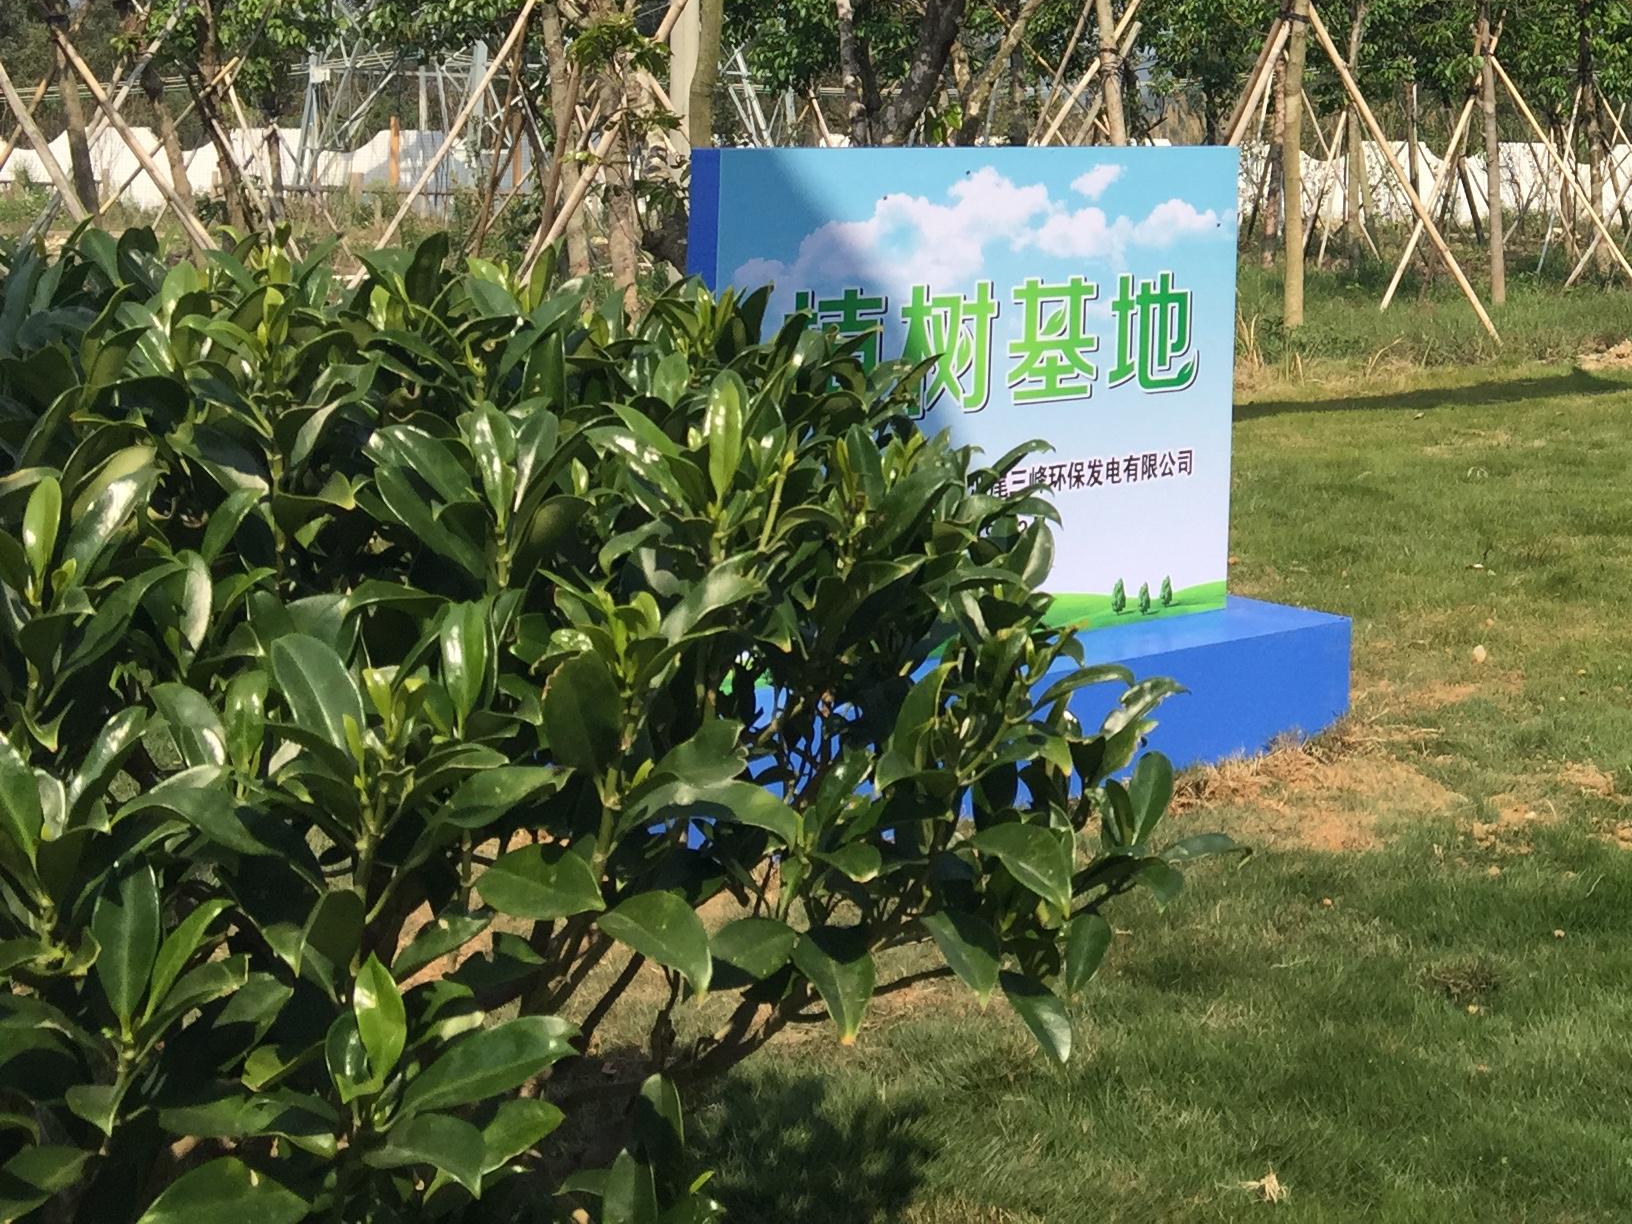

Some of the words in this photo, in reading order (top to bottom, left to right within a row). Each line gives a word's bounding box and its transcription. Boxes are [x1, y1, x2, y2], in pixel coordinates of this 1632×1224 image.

[968, 449, 1194, 498] 三峰环保发电有限公司
